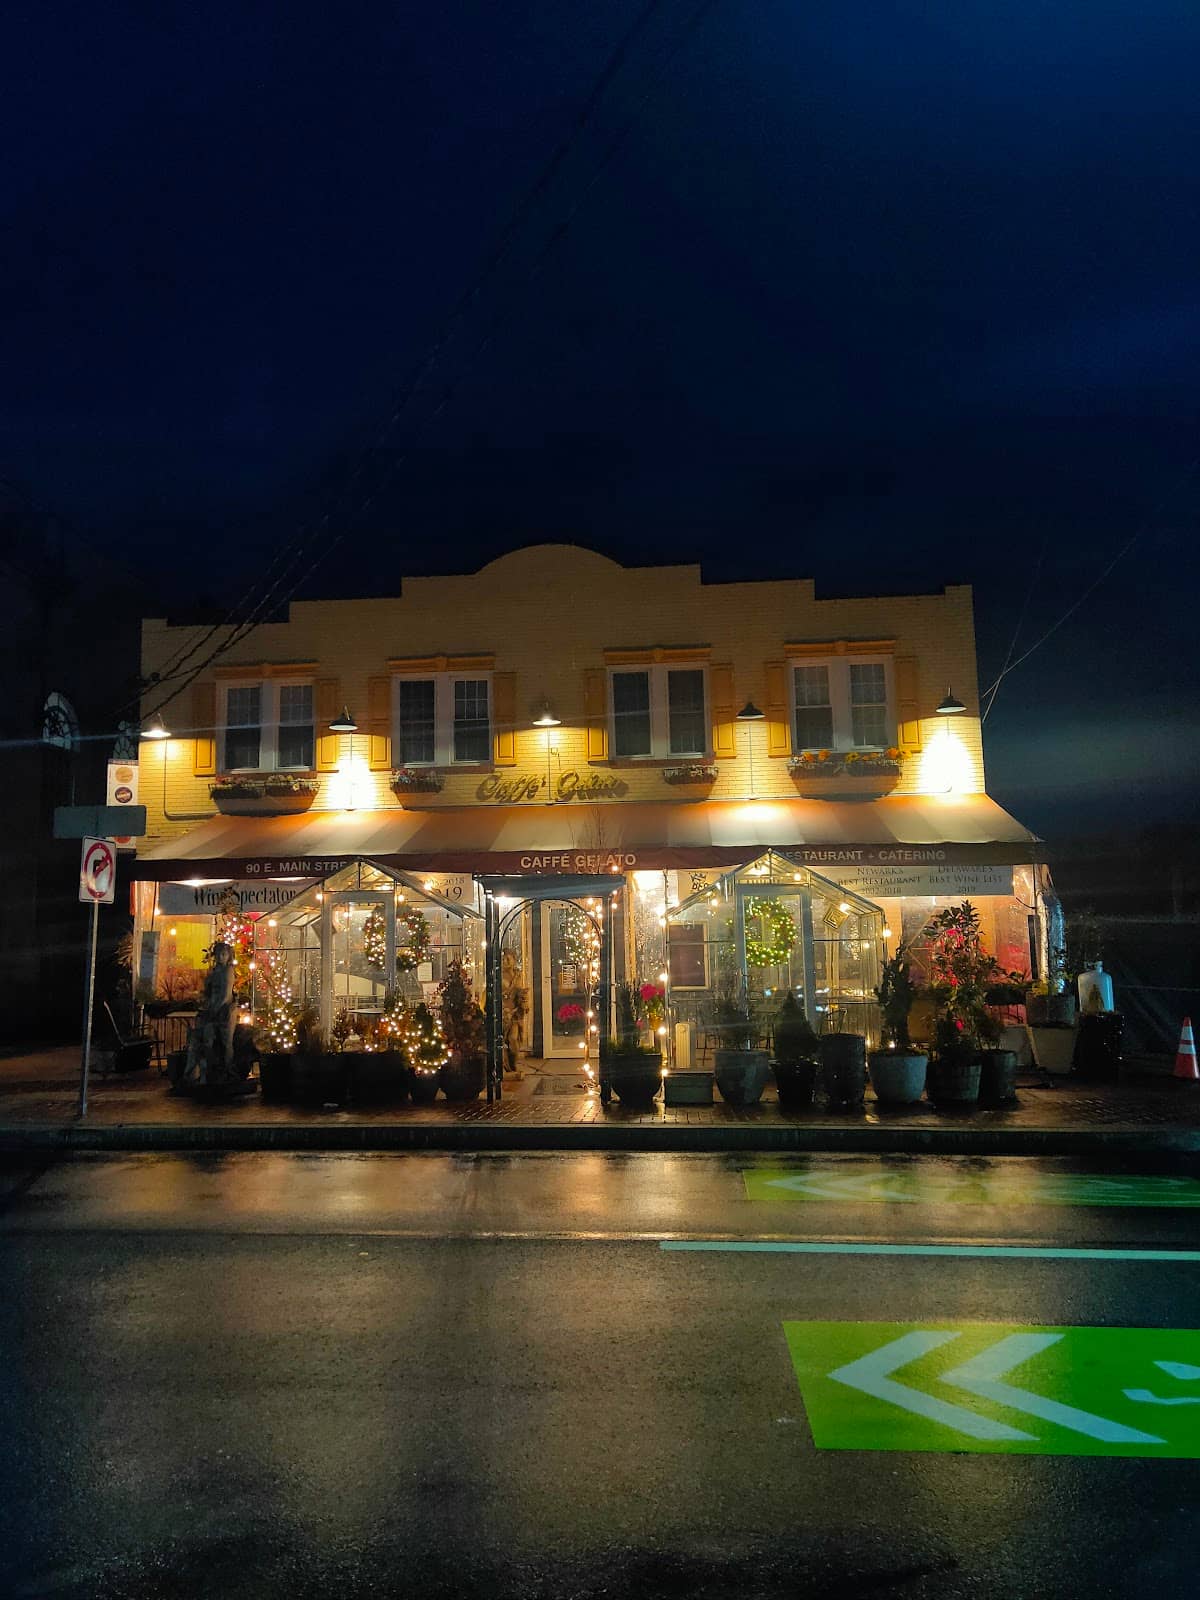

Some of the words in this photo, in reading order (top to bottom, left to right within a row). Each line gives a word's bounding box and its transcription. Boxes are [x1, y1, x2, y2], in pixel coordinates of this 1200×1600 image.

[520, 853, 571, 869] CAFFÉ
[575, 854, 637, 868] GELATO
[878, 849, 946, 861] CATERING
[246, 863, 260, 873] 90
[264, 863, 275, 873] E.
[279, 861, 311, 873] MAIN
